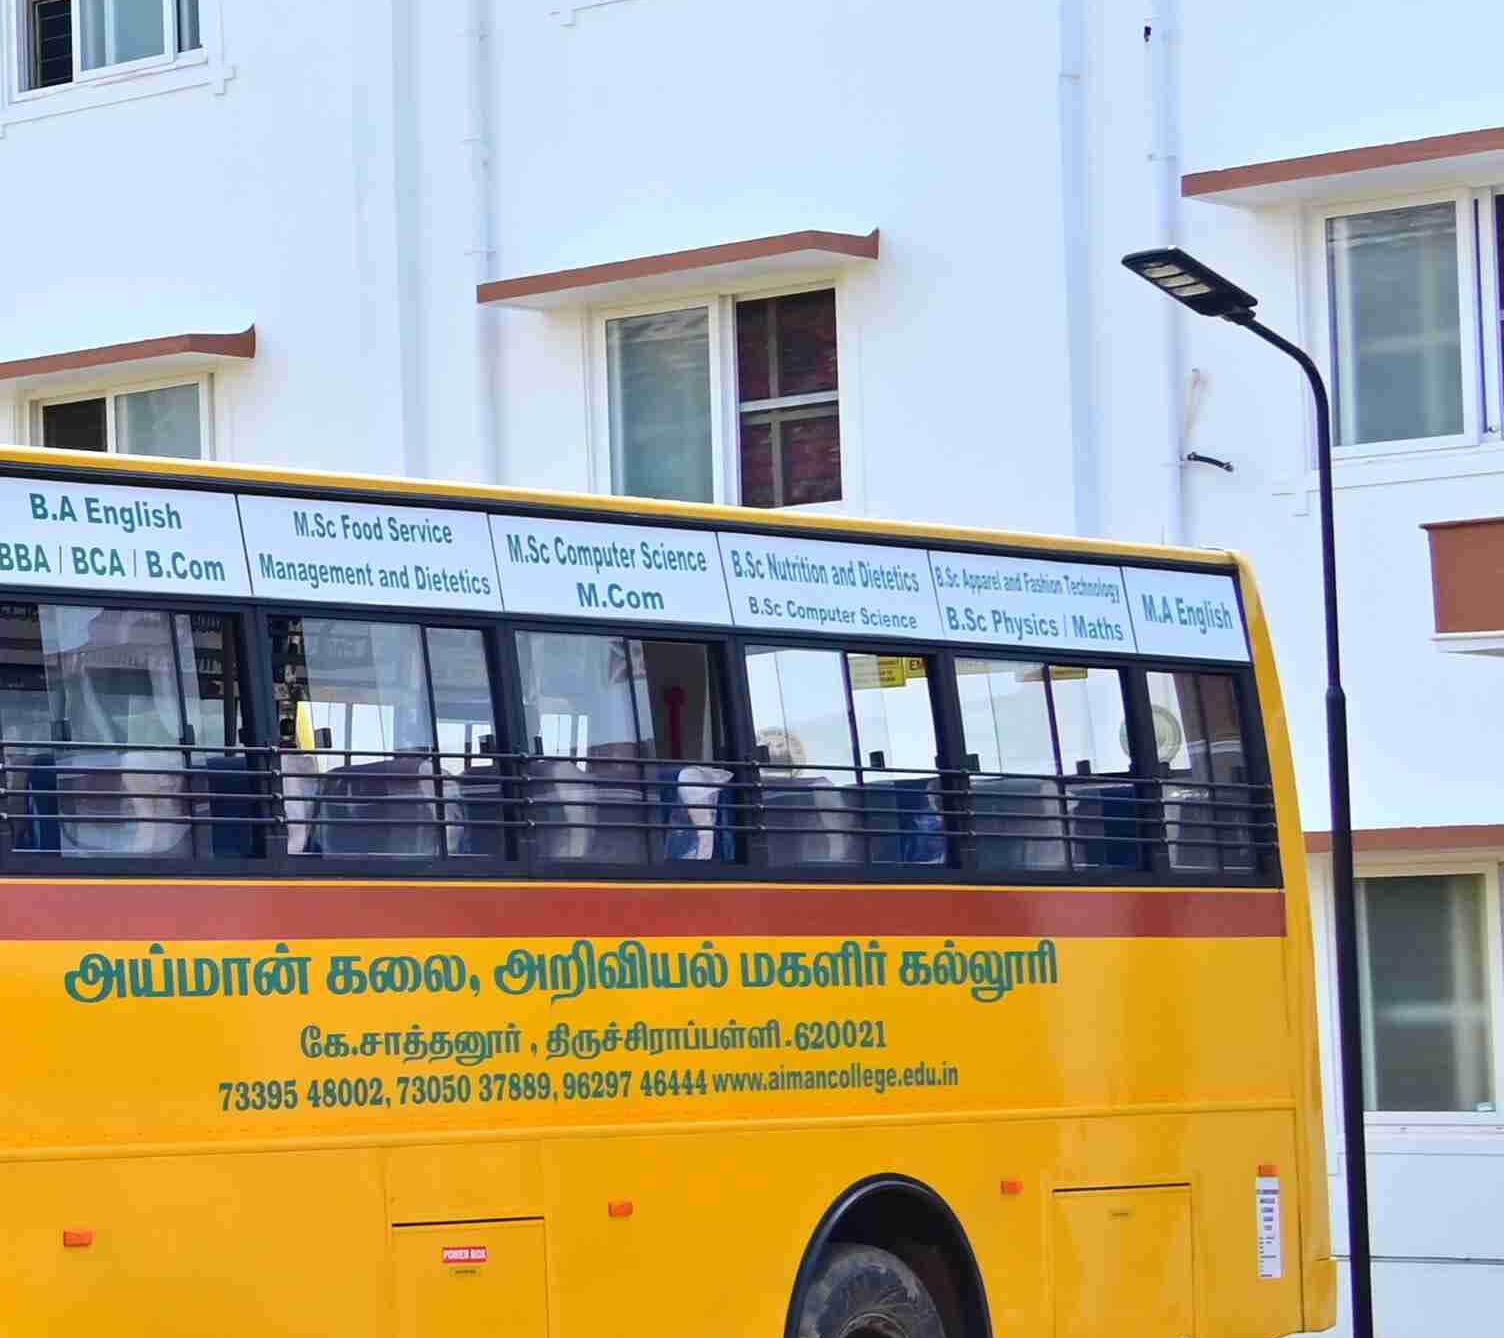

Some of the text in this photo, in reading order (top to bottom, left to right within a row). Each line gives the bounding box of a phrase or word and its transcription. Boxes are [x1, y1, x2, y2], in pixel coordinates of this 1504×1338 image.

[29, 492, 183, 534] B.A English
[292, 510, 453, 544] M.Sc Food Service
[71, 546, 126, 577] BCA
[145, 549, 226, 582] B.Com
[258, 552, 491, 596] Management and Dietetics
[505, 533, 707, 574] M.Sc Computer Science
[731, 549, 920, 593] B.Sc Nutrition and Dietetics
[575, 582, 665, 610] M.Com
[962, 568, 1002, 594] Apparel
[1002, 572, 1023, 592] and
[1023, 572, 1063, 595] Fashion
[1062, 574, 1121, 604] Technology
[748, 596, 918, 630] B.Sc Computer Science
[945, 605, 988, 633] B.Sc
[990, 609, 1060, 641] Physics
[1071, 614, 1124, 642] Maths
[1141, 593, 1235, 635] M.A English
[63, 939, 1058, 1005] அய்மான் கலை, அறிவியல் மகளிர் கல்லூரி
[218, 1080, 299, 1111] 73395
[306, 1077, 392, 1109] 48002,
[396, 1075, 472, 1105] 73050
[562, 1070, 633, 1100] 96297
[639, 1067, 708, 1097] 46444
[712, 1060, 959, 1094] www.aimancollege.edu.in
